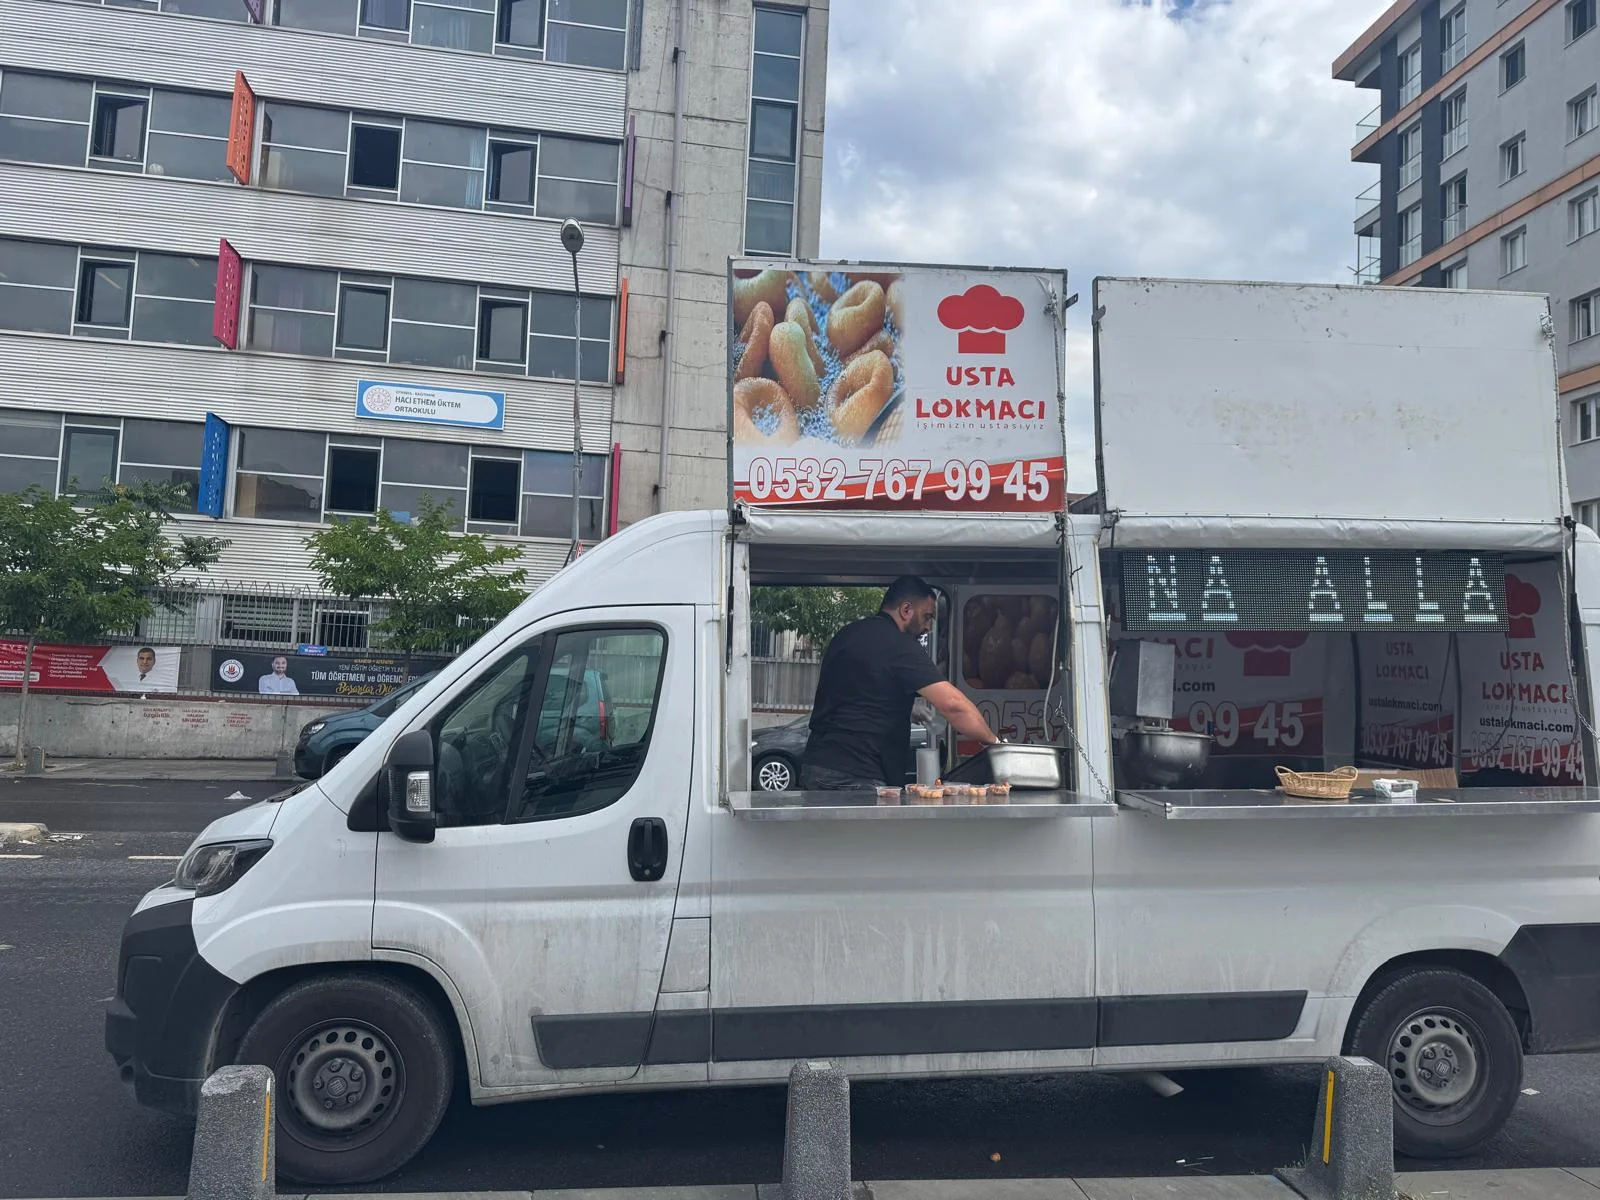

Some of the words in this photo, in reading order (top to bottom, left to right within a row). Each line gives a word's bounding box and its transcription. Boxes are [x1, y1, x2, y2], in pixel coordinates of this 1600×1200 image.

[945, 366, 1016, 388] USTA
[394, 405, 436, 415] ORTAOKULU
[395, 395, 412, 404] HACI
[412, 397, 437, 406] ETHEM
[437, 399, 461, 409] ÜKTEM
[915, 398, 1046, 420] LOKMACI
[916, 420, 975, 430] işimizin
[980, 421, 1046, 431] ustasıyız
[749, 456, 847, 500] 0532
[859, 458, 932, 501] 767
[943, 459, 991, 501] 99
[1003, 460, 1050, 501] 45
[1147, 554, 1238, 621] NA
[1308, 555, 1498, 622] ALLA
[1385, 641, 1414, 657] USTA
[1376, 663, 1429, 680] LOKMACI
[1500, 651, 1545, 672] USTA
[311, 671, 327, 681] TÜM
[328, 671, 366, 682] ÖĞRETMEN
[1482, 681, 1568, 704] LOKMACI
[1368, 695, 1443, 713] ustalokmaci.com
[976, 700, 1064, 743] 053
[1189, 701, 1240, 747] 99
[1253, 701, 1305, 748] 45
[1480, 716, 1574, 733] ustalokmaci.com
[1390, 725, 1413, 760] 767
[1415, 729, 1429, 763] 99
[1431, 732, 1448, 767] 45
[1507, 734, 1536, 775] 767
[1541, 737, 1561, 778] 99
[1565, 740, 1585, 782] 45
